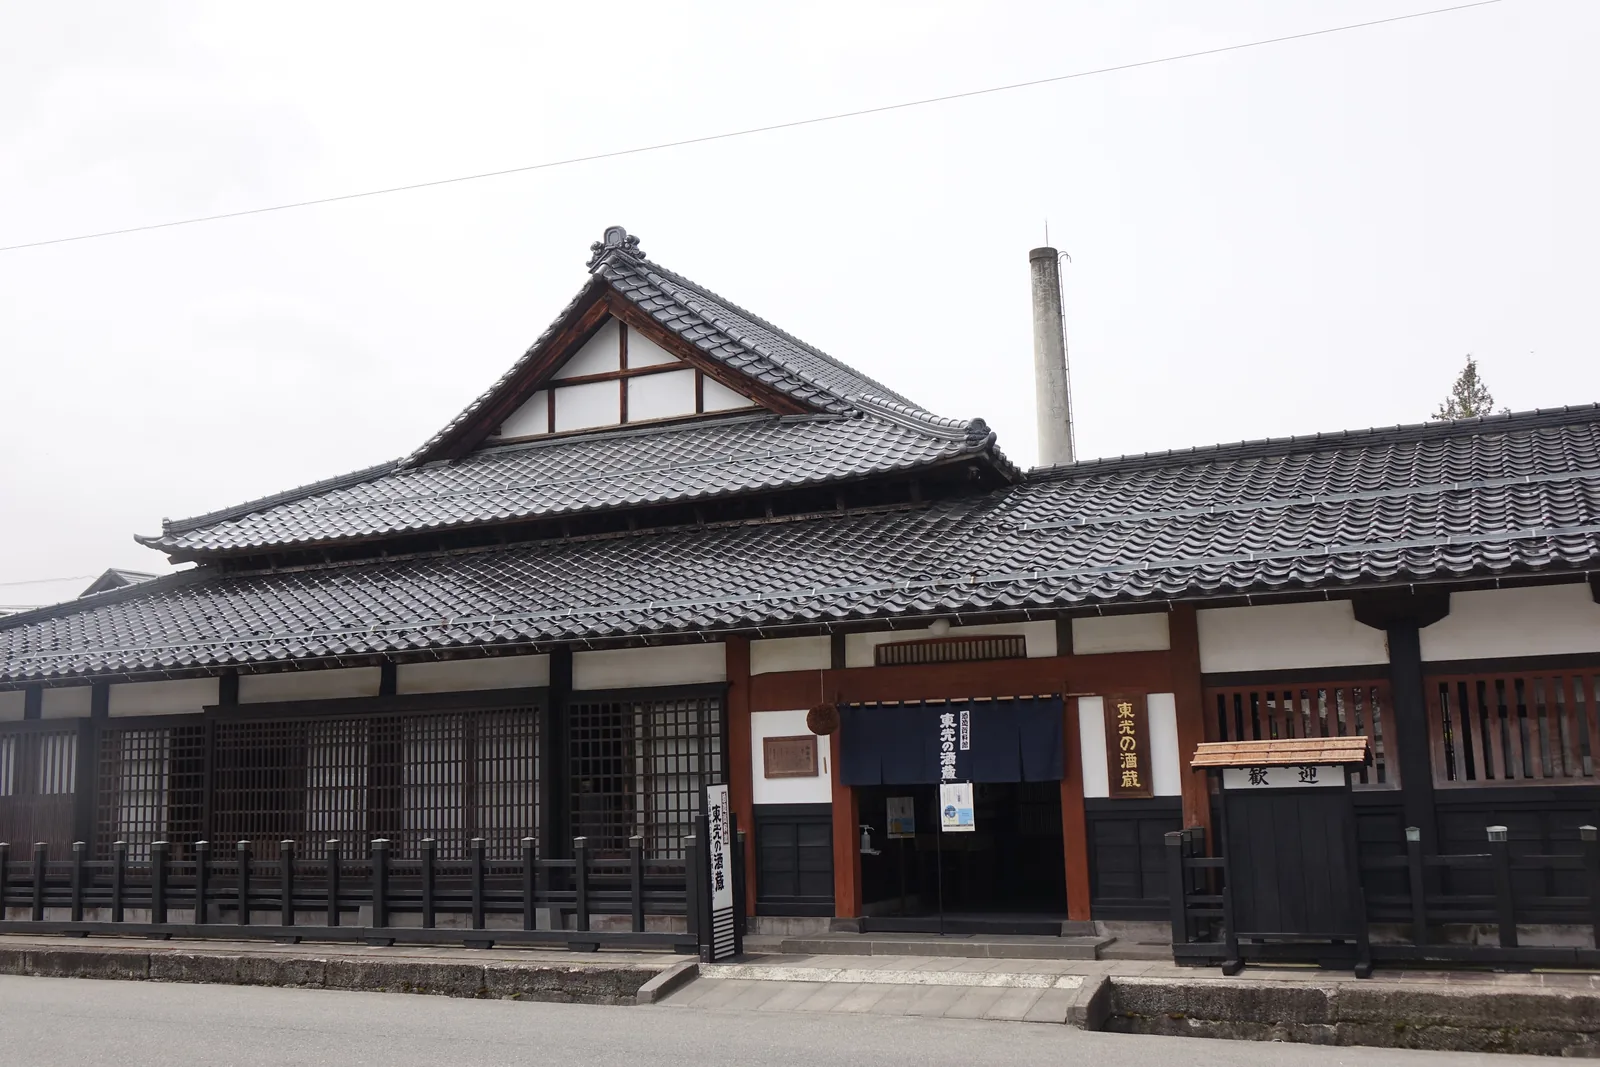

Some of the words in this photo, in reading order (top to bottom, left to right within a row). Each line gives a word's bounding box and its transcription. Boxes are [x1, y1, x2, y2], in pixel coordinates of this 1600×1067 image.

[940, 713, 957, 778] 東光の酒蔵
[1117, 702, 1140, 787] 東光の酒蔵
[712, 804, 724, 892] 東光の酒蔵
